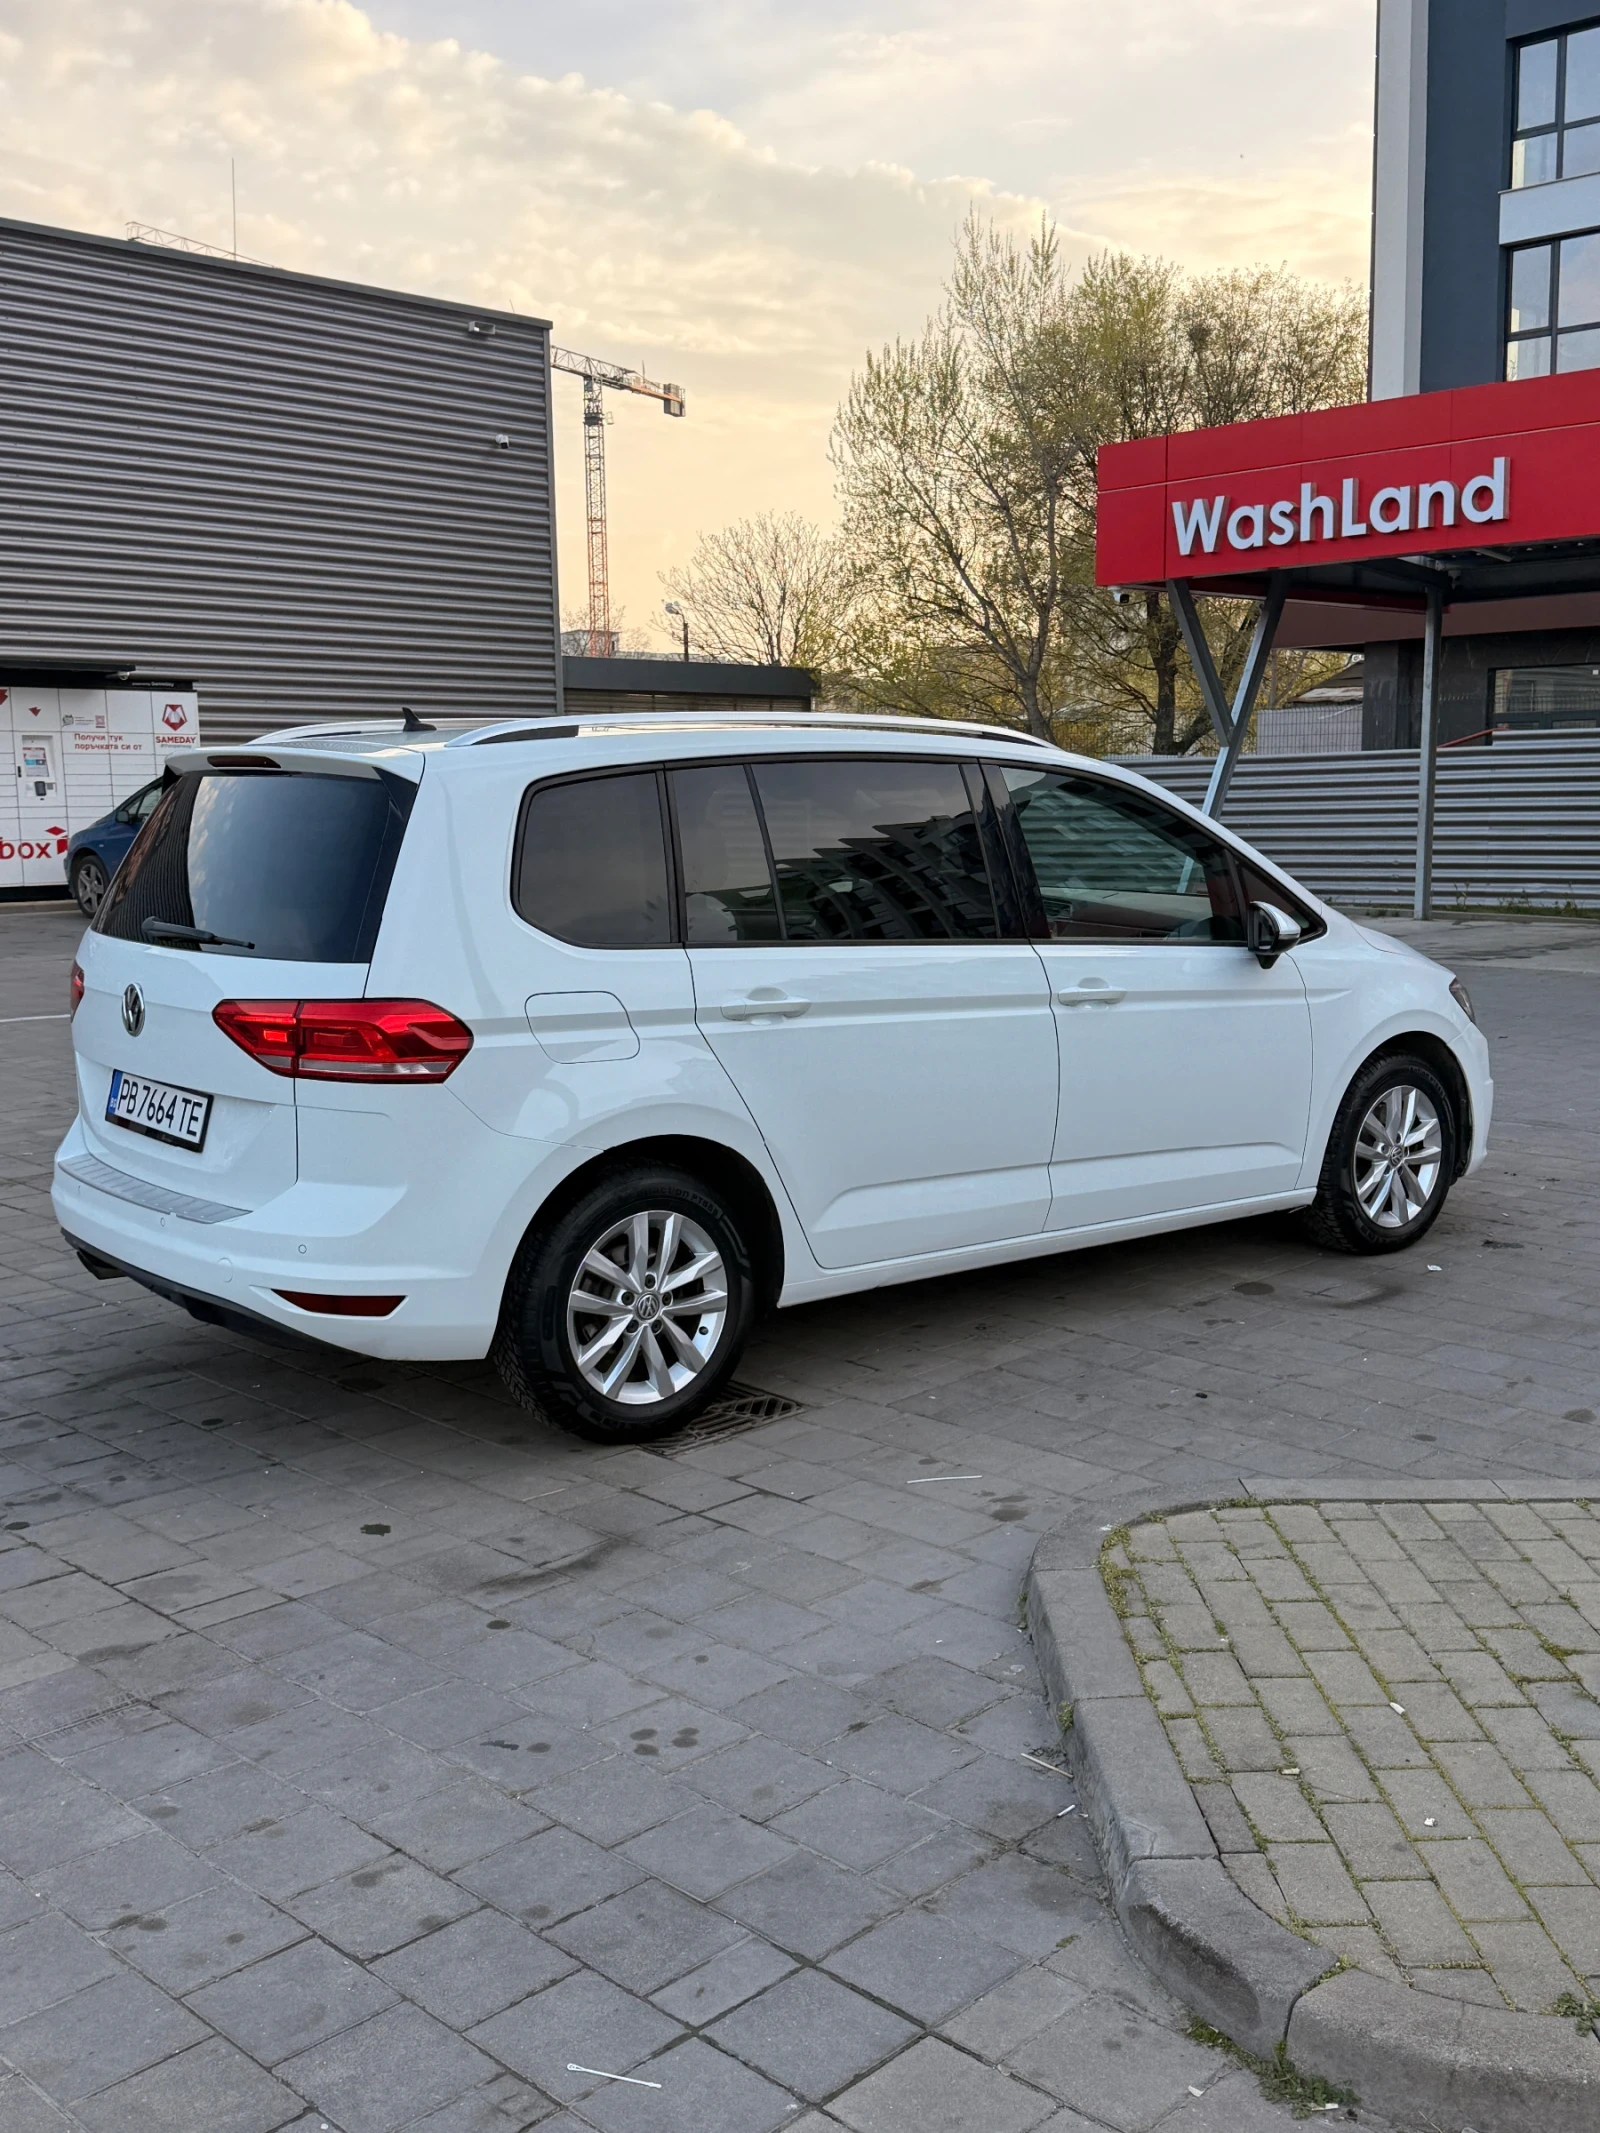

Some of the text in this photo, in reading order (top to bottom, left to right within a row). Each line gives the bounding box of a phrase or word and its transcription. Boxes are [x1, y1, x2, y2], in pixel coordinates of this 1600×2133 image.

[1172, 457, 1510, 556] WashLand
[74, 733, 123, 743] Получи тук
[155, 736, 196, 744] SAMEDAY
[75, 743, 118, 751] поръчката
